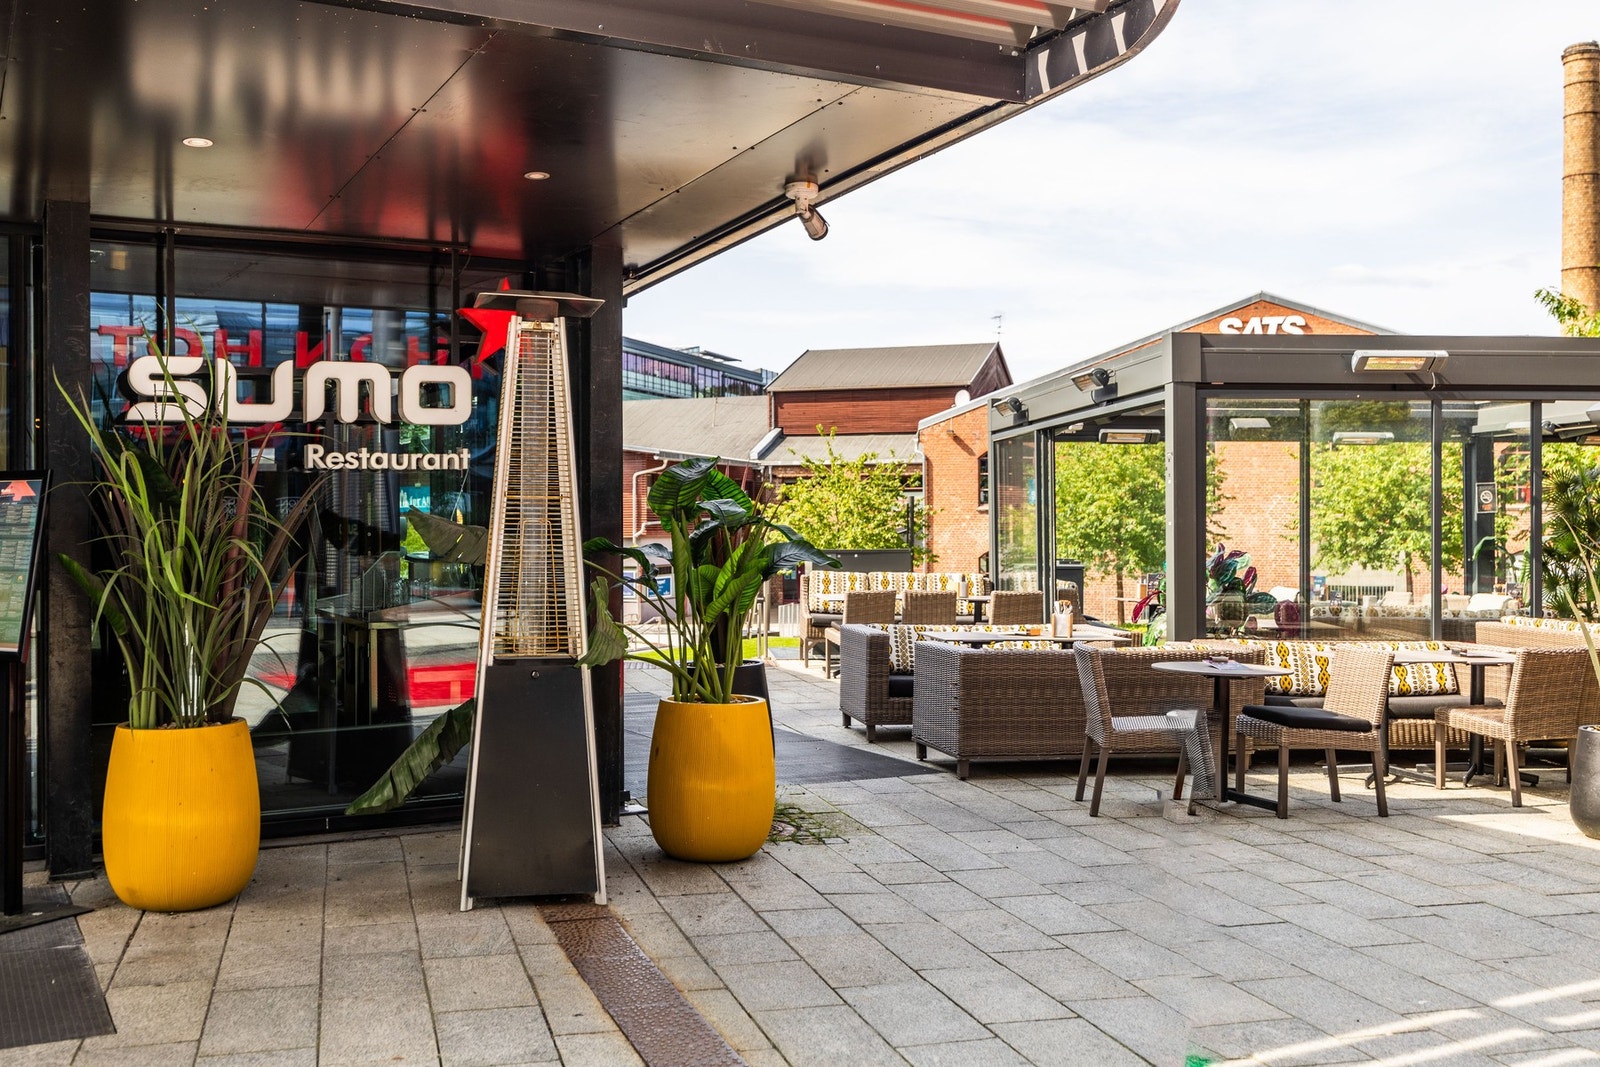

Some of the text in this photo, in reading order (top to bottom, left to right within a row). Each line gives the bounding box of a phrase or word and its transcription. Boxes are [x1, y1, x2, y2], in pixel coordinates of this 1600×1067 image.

[1219, 315, 1306, 334] SATS
[126, 356, 472, 425] SUMO
[307, 443, 471, 470] Restaurant
